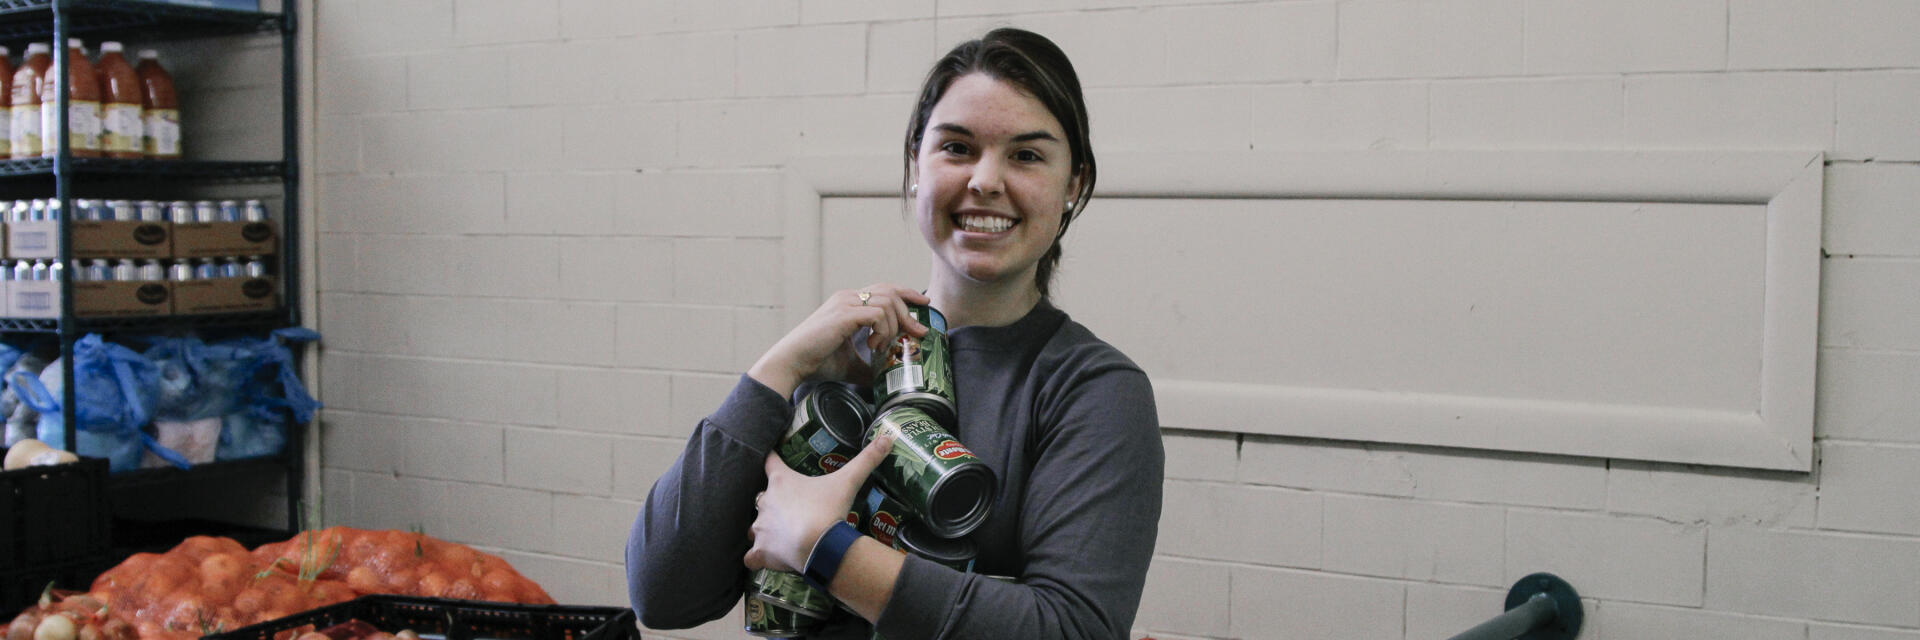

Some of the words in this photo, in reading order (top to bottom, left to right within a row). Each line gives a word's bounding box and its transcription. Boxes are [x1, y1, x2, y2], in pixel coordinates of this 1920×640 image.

[902, 420, 931, 433] BEANS
[905, 425, 929, 440] STYLE
[824, 457, 837, 467] Del
[873, 516, 886, 531] Del
